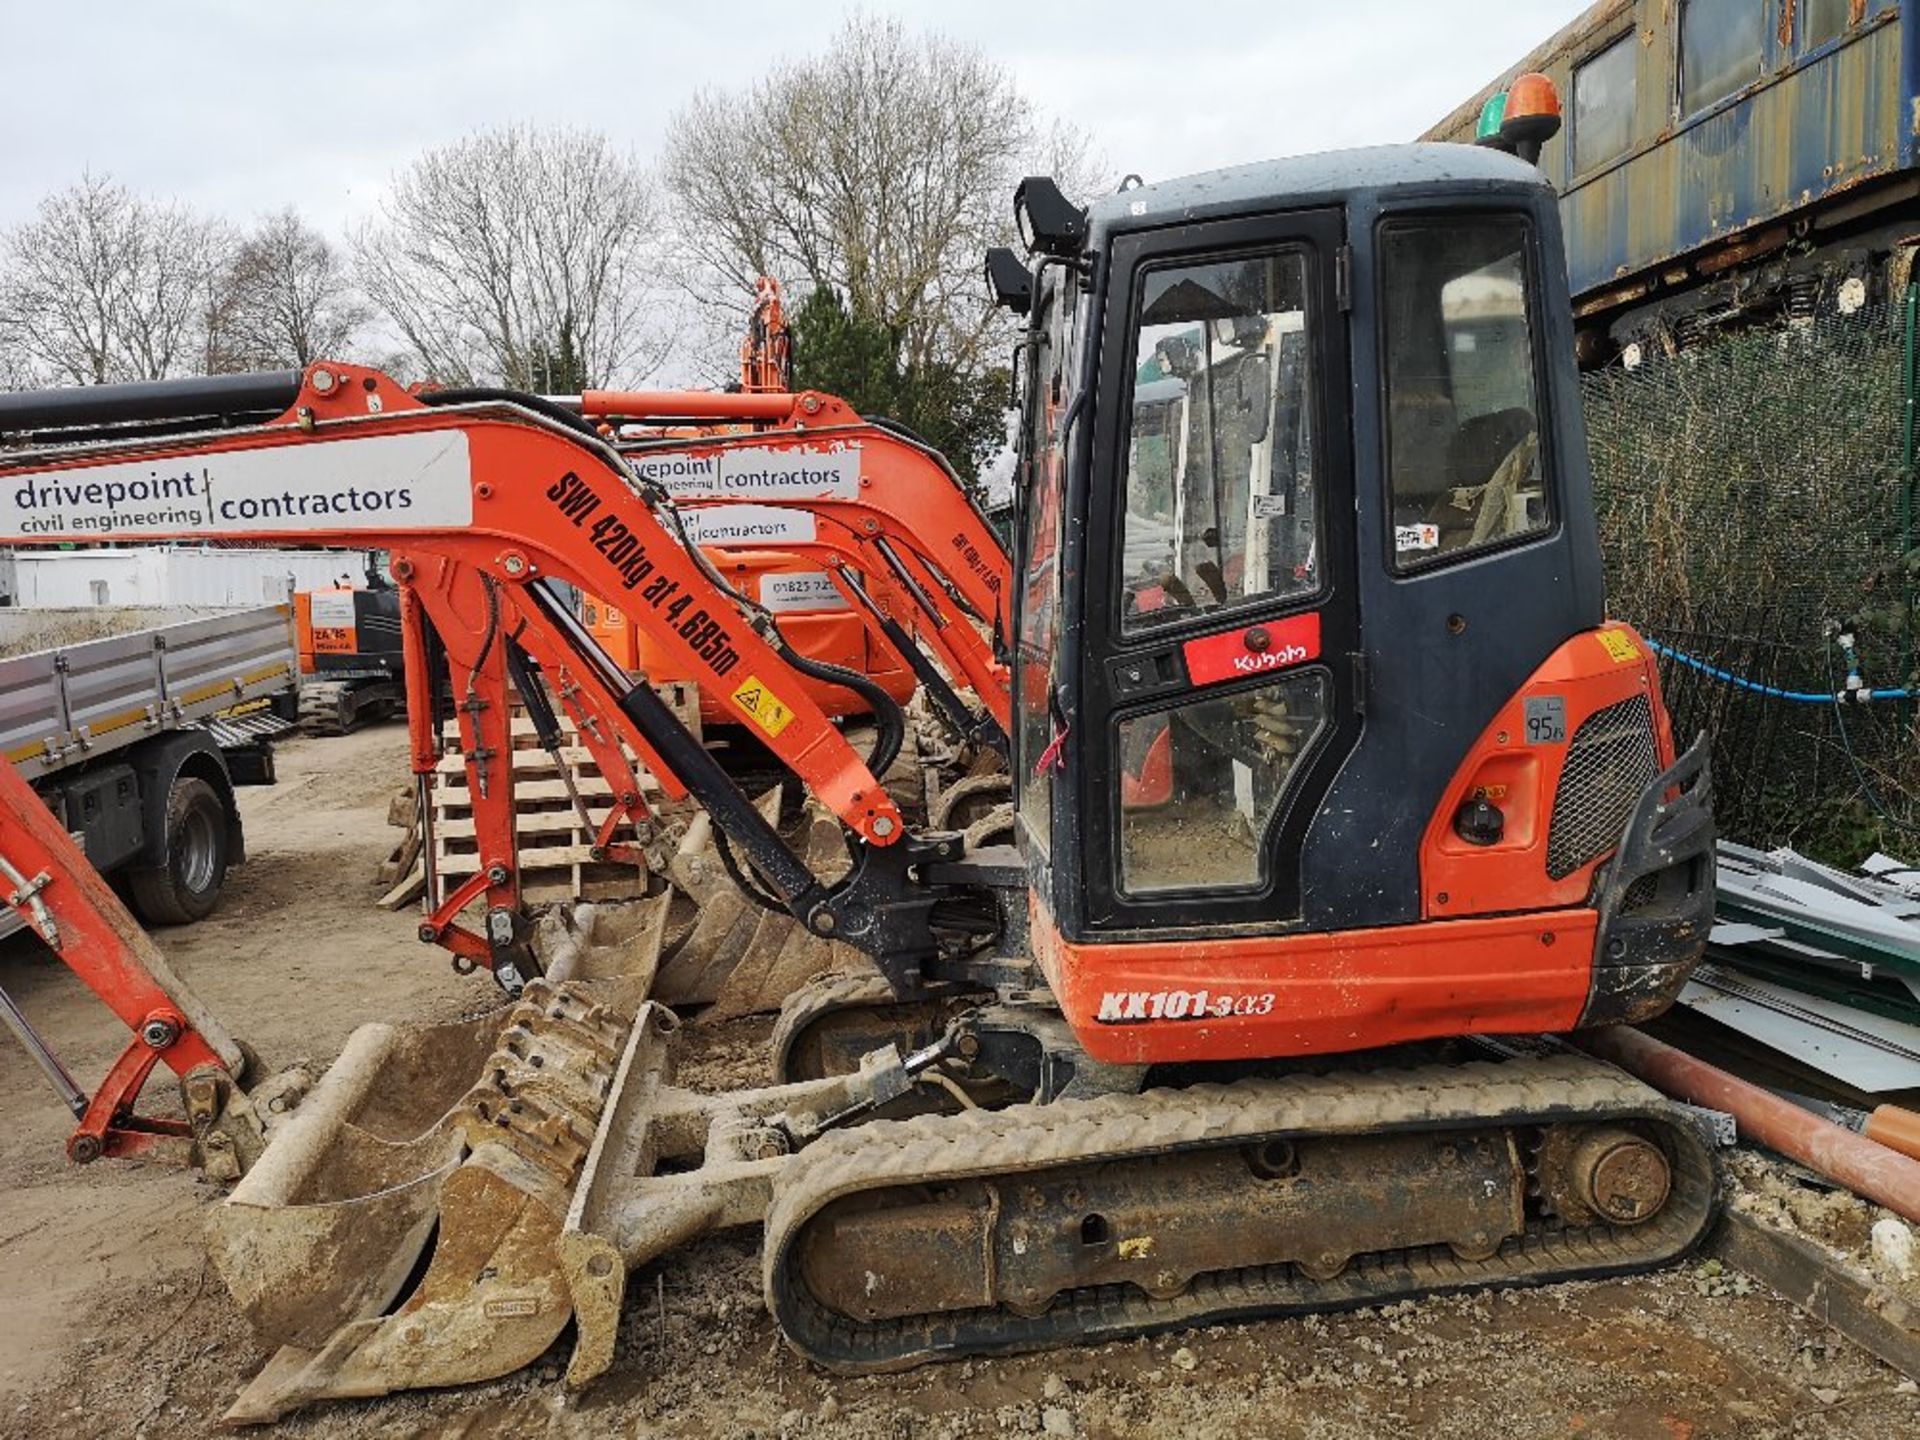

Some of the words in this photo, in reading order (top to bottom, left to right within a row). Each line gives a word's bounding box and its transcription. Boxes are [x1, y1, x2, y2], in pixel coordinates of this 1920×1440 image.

[15, 471, 198, 510] drivepoint
[724, 468, 841, 489] contractors
[220, 486, 413, 520] contractors
[20, 514, 65, 533] civil
[72, 506, 202, 533] engineering
[701, 521, 787, 539] contractors
[546, 471, 602, 528] SWL
[589, 513, 655, 591] 420kg
[641, 575, 681, 609] at
[665, 594, 740, 677] 4.685m
[1528, 716, 1552, 740] 95
